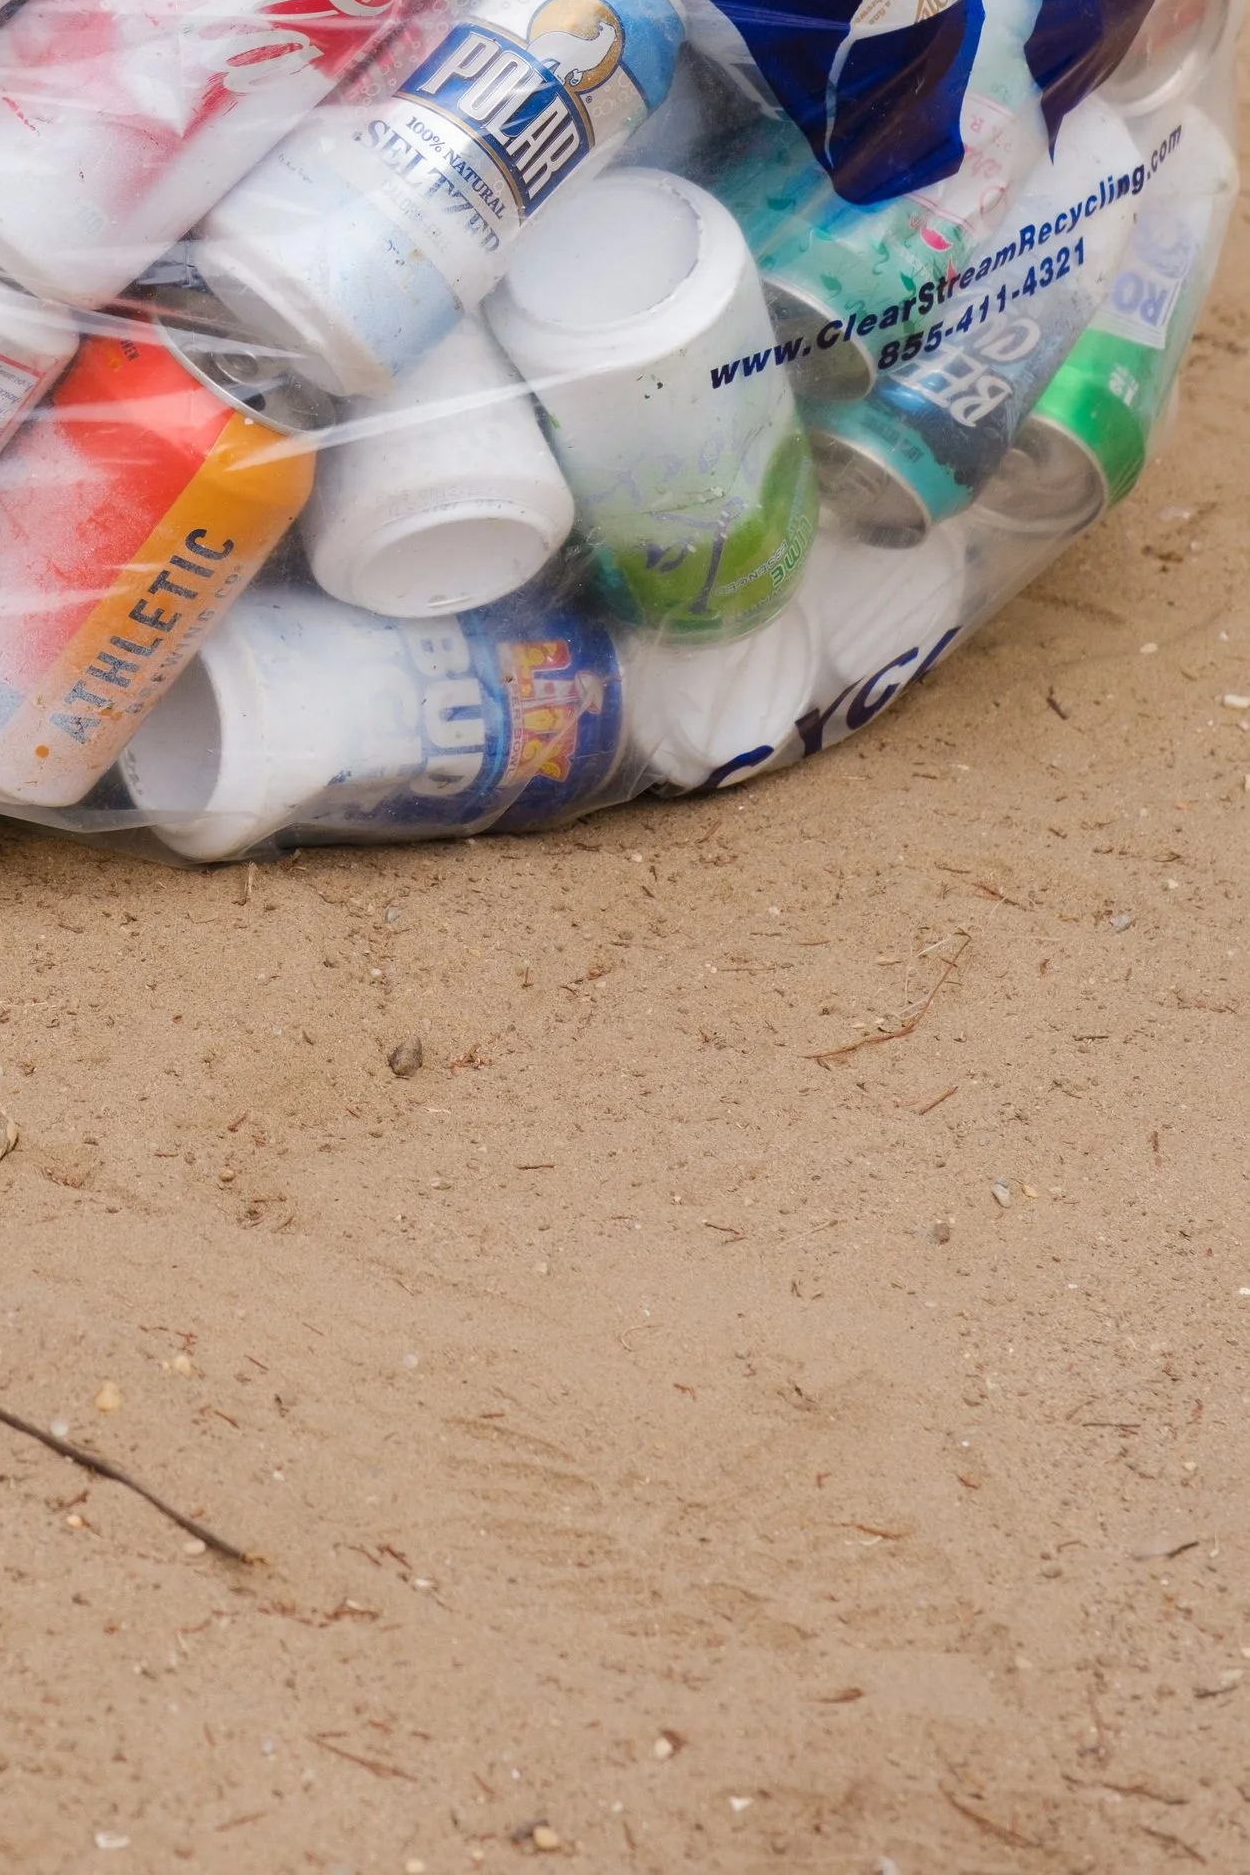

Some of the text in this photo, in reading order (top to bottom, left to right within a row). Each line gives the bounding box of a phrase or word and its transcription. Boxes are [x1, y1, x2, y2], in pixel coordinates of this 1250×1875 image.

[405, 115, 507, 221] 100% NATURAL
[420, 37, 584, 199] POLAR
[710, 124, 1183, 390] www.ClearStreamRecycling.com
[878, 236, 1087, 371] 855-411-4321
[770, 515, 812, 587] LIME
[49, 520, 237, 746] ATHLETIC
[405, 616, 484, 799] BUD
[505, 728, 522, 778] BOWL
